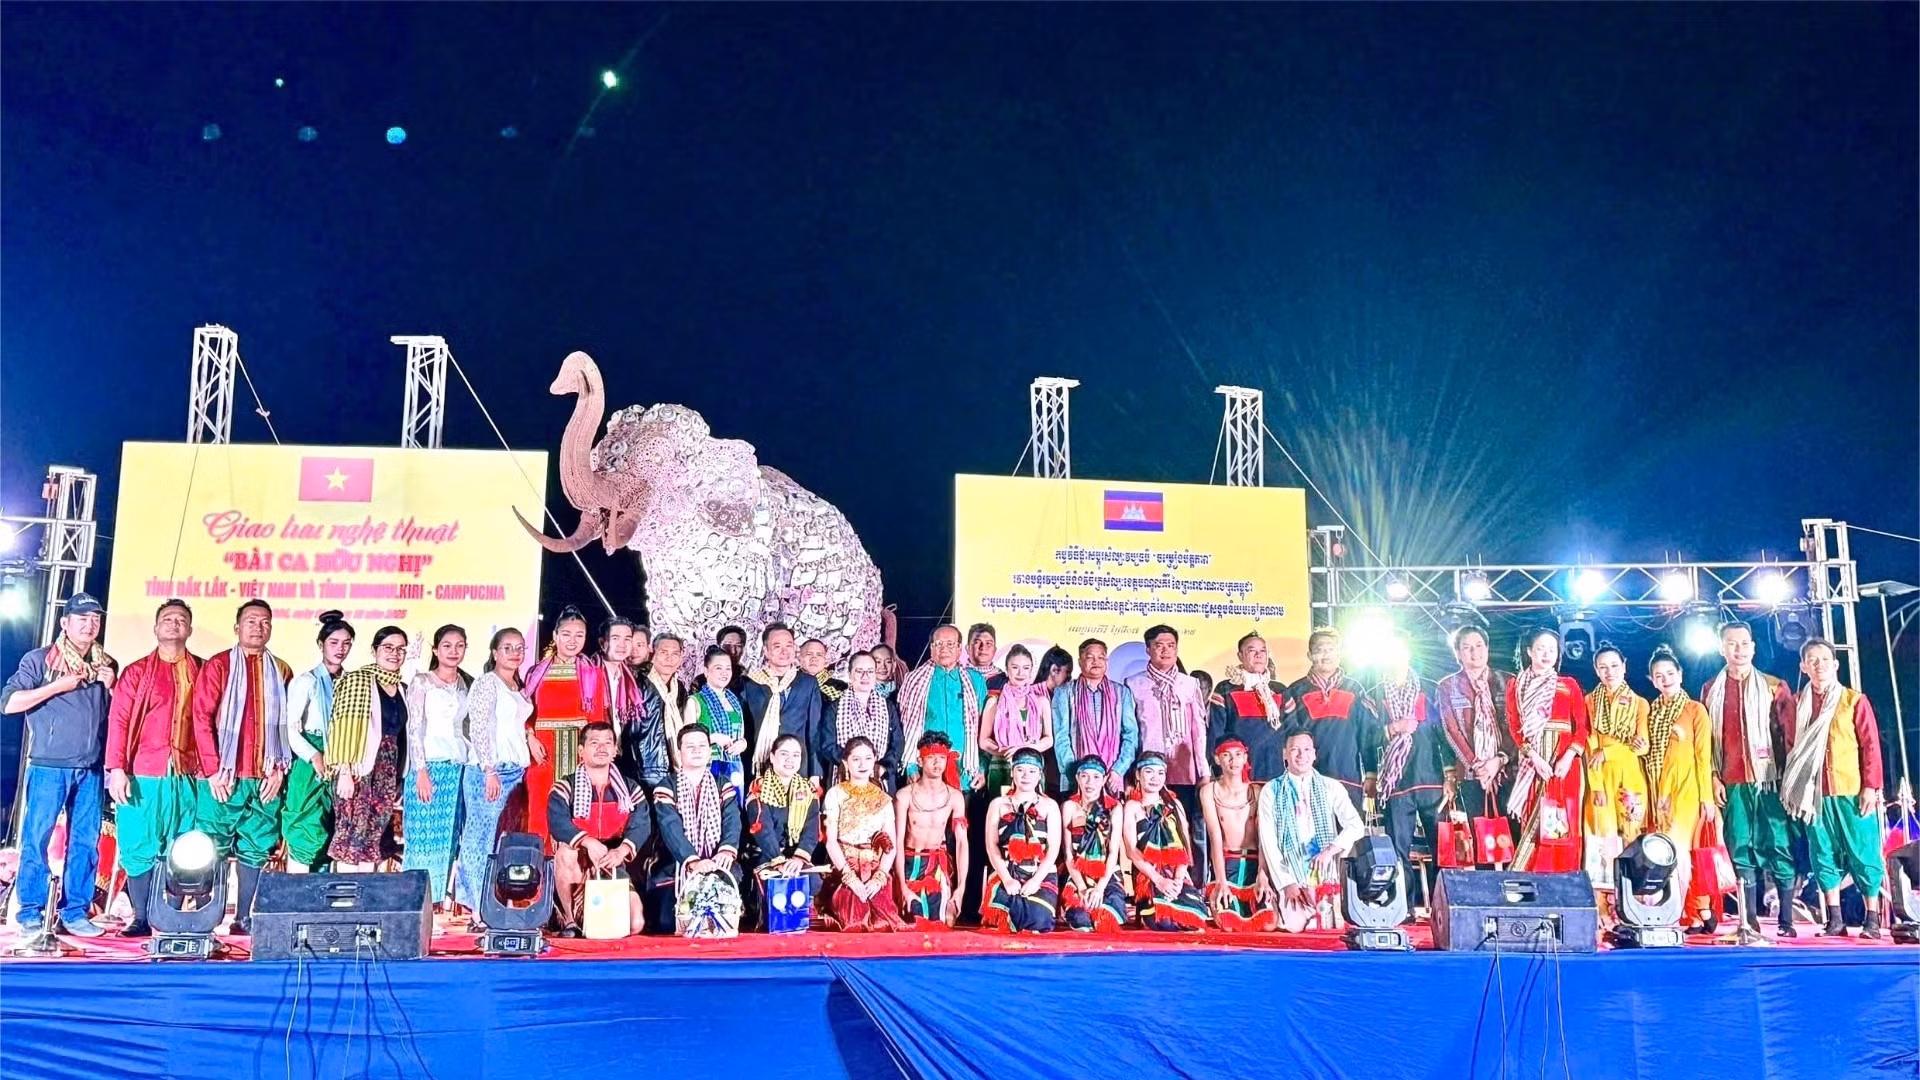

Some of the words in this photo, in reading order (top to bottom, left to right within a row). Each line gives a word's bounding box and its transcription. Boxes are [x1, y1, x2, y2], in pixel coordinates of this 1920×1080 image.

[203, 510, 276, 544] Giao
[391, 516, 459, 547] thuật
[277, 552, 309, 572] CA
[239, 579, 265, 597] VIỆT
[435, 584, 506, 600] CAMPUCHIA
